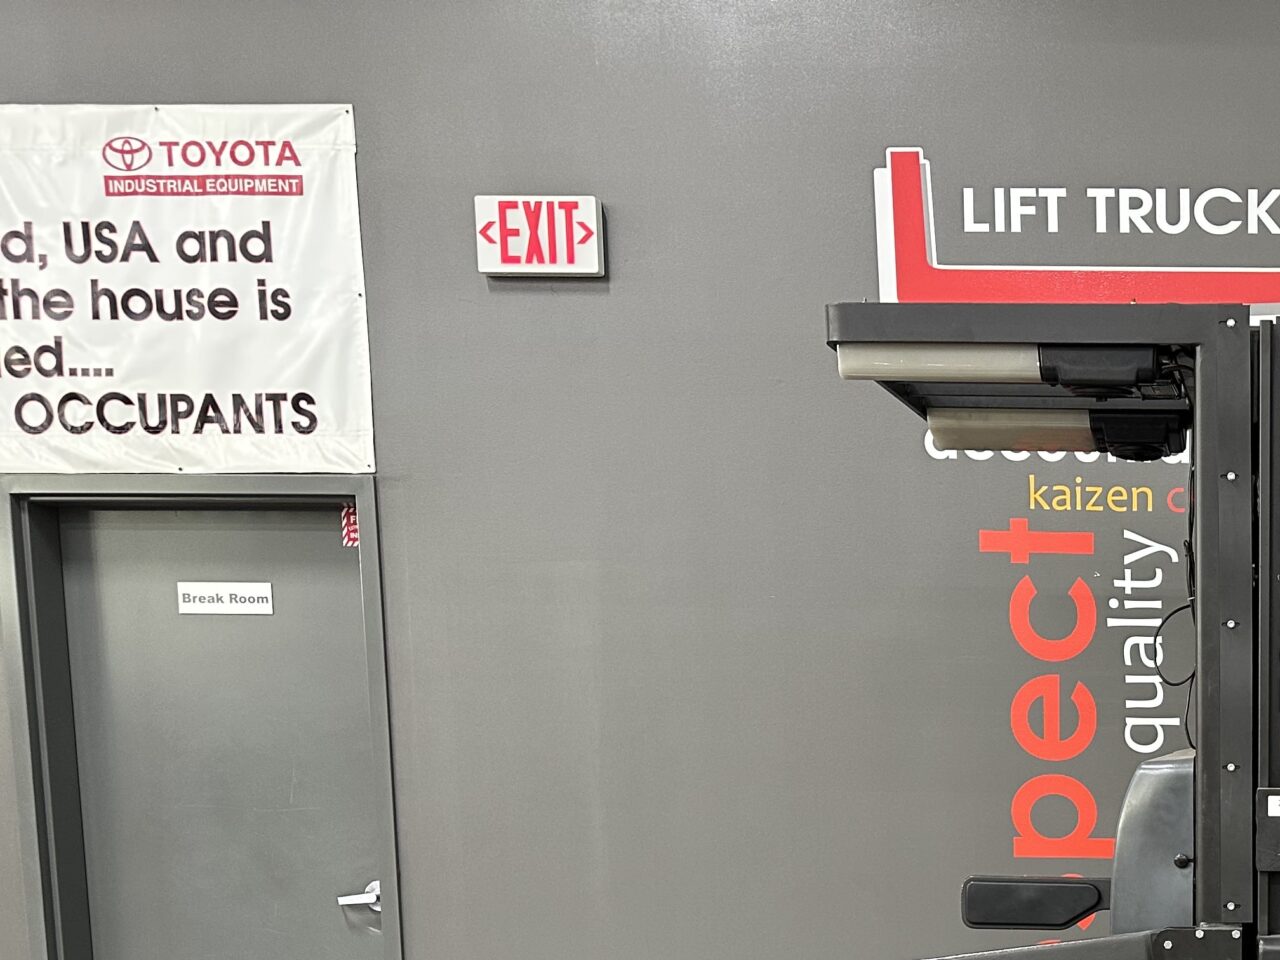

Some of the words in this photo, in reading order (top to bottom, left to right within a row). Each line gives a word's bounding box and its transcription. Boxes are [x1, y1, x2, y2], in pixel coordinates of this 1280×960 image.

[159, 140, 301, 167] TOYOTA
[109, 179, 203, 194] INDUSTRIAL
[206, 178, 299, 193] EQUIPMENT
[498, 201, 578, 264] EXIT
[963, 187, 1068, 235] LIFT
[0, 221, 48, 270] d,
[62, 220, 160, 264] USA
[176, 220, 273, 263] and
[0, 278, 74, 321] the
[90, 279, 239, 321] house
[257, 278, 292, 321] is
[14, 392, 318, 435] OCCUPANTS
[1029, 474, 1153, 512] kaizen
[182, 593, 224, 604] Break
[229, 593, 269, 604] Room
[1107, 529, 1180, 754] quality
